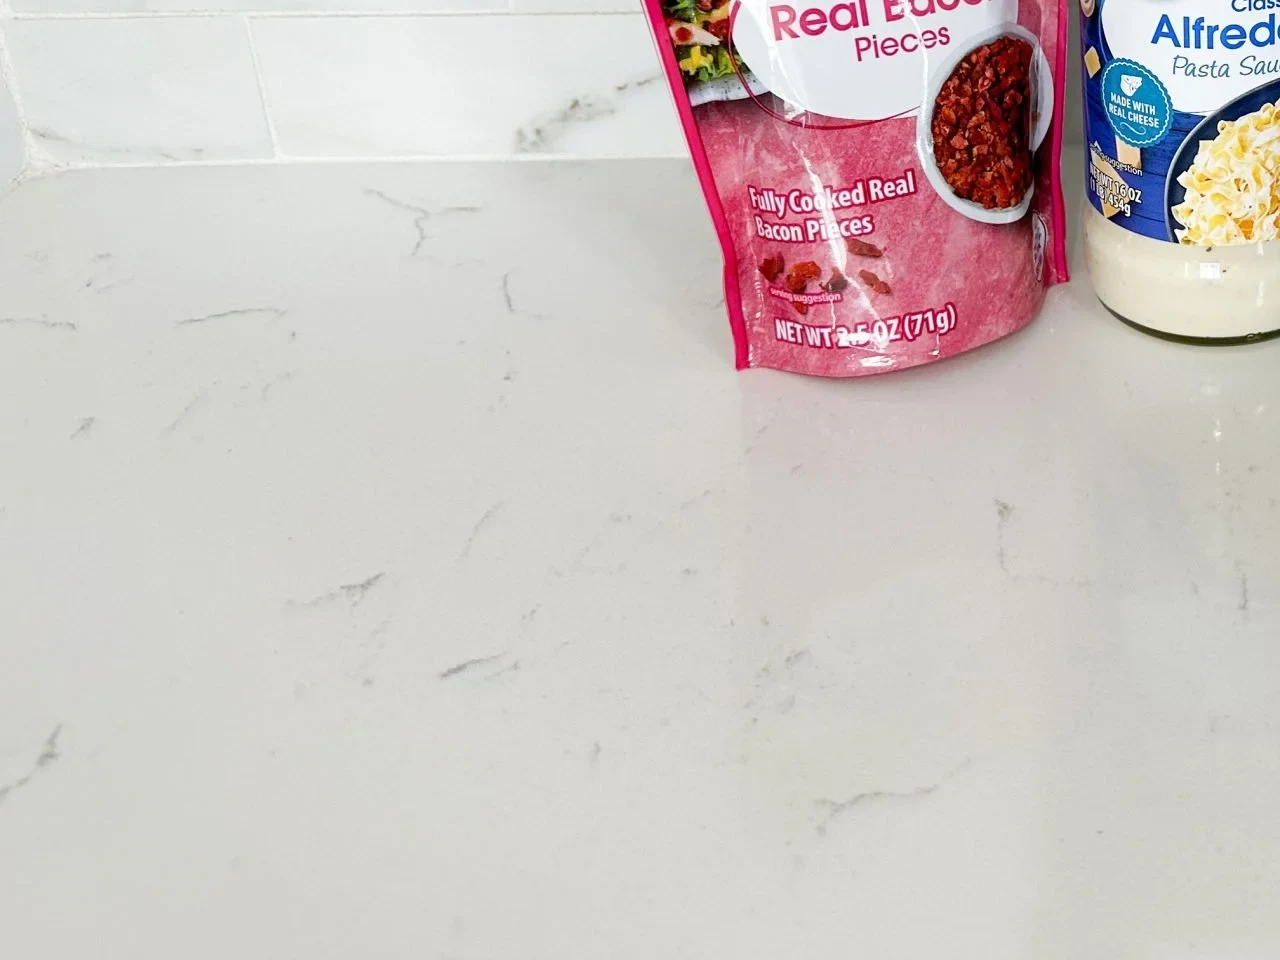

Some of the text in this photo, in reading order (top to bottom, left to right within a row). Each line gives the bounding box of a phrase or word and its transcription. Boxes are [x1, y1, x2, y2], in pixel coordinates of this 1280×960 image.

[854, 26, 951, 62] Pieces
[1172, 54, 1231, 79] Pasta
[1108, 104, 1160, 128] REAL CHEESE
[1110, 92, 1156, 115] MADE WITH
[749, 170, 917, 218] Fully Cooked Real
[1101, 172, 1114, 191] WT
[1114, 180, 1127, 197] 16
[1127, 187, 1142, 204] OZ
[1108, 192, 1131, 217] 454g
[754, 214, 874, 242] Bacon Pieces
[793, 292, 842, 304] suggestion
[775, 318, 802, 344] NET
[804, 324, 832, 348] WT
[872, 317, 901, 345] OZ
[903, 303, 957, 342] (71g)
